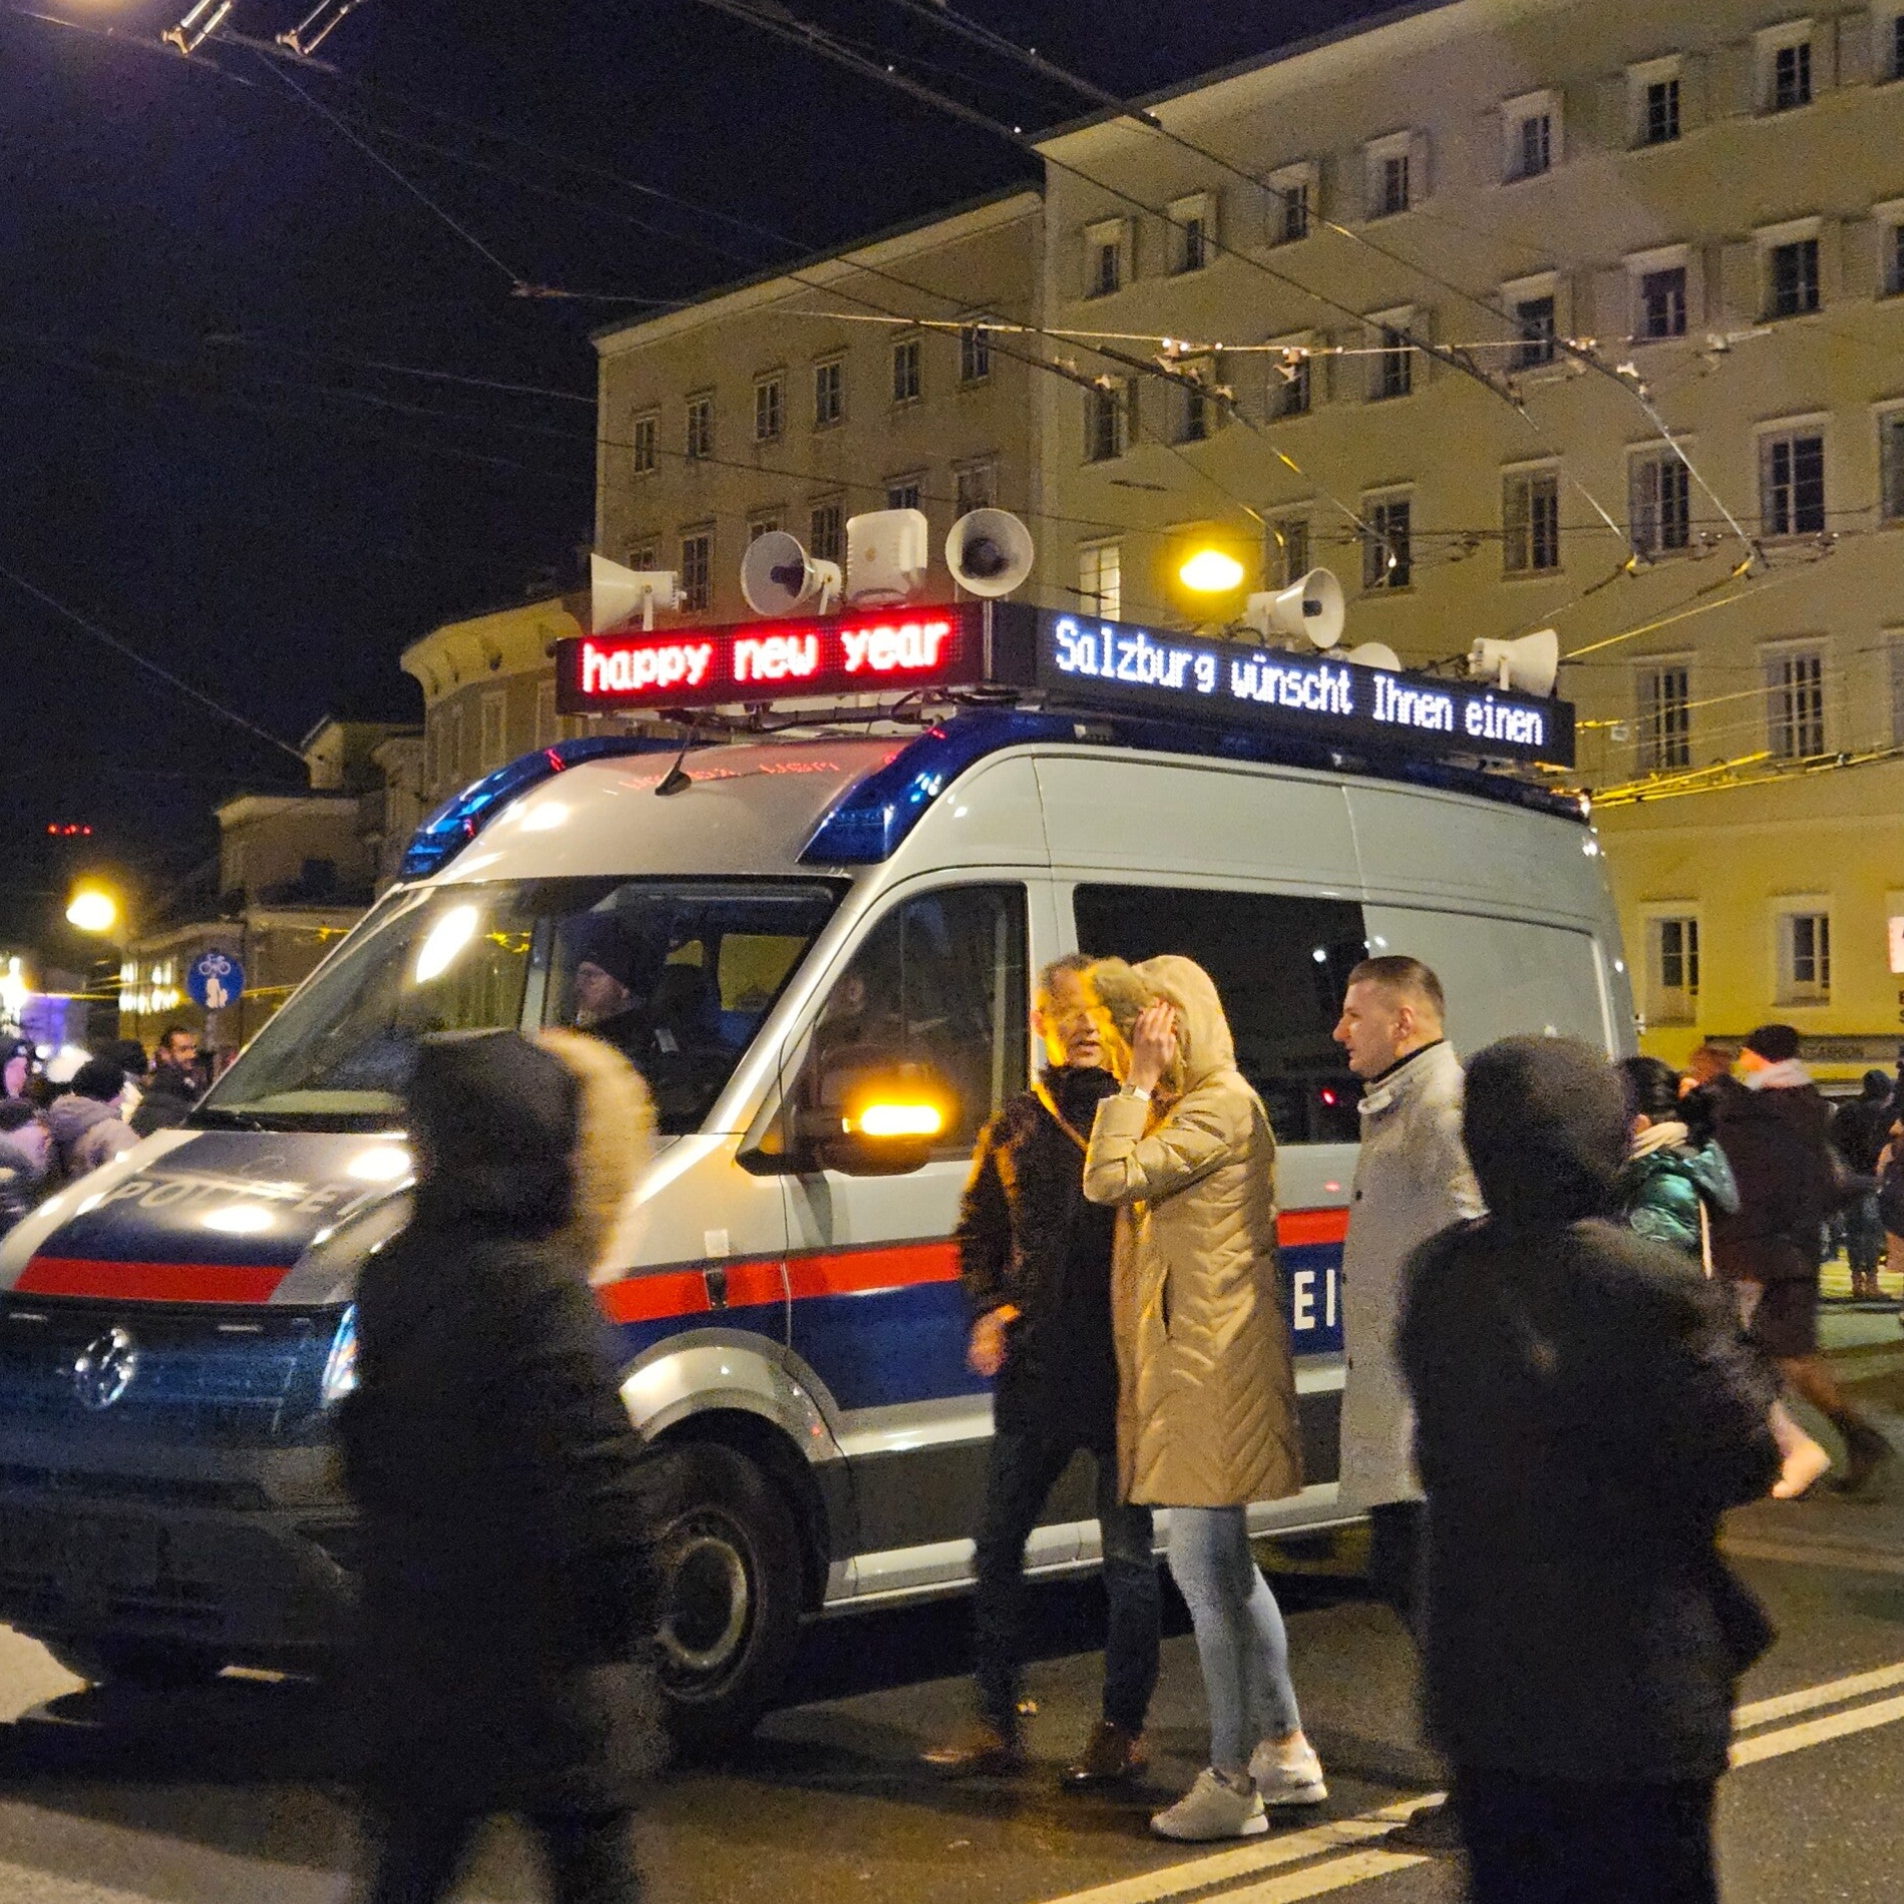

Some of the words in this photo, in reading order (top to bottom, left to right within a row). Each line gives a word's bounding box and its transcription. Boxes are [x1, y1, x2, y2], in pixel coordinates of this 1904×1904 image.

[583, 643, 713, 693] happy
[734, 634, 819, 682] new
[841, 622, 951, 673] year
[1055, 617, 1217, 693] Salzburg
[1230, 653, 1354, 715] wünscht
[1373, 675, 1454, 732] Ihnen
[1465, 695, 1544, 747] einen
